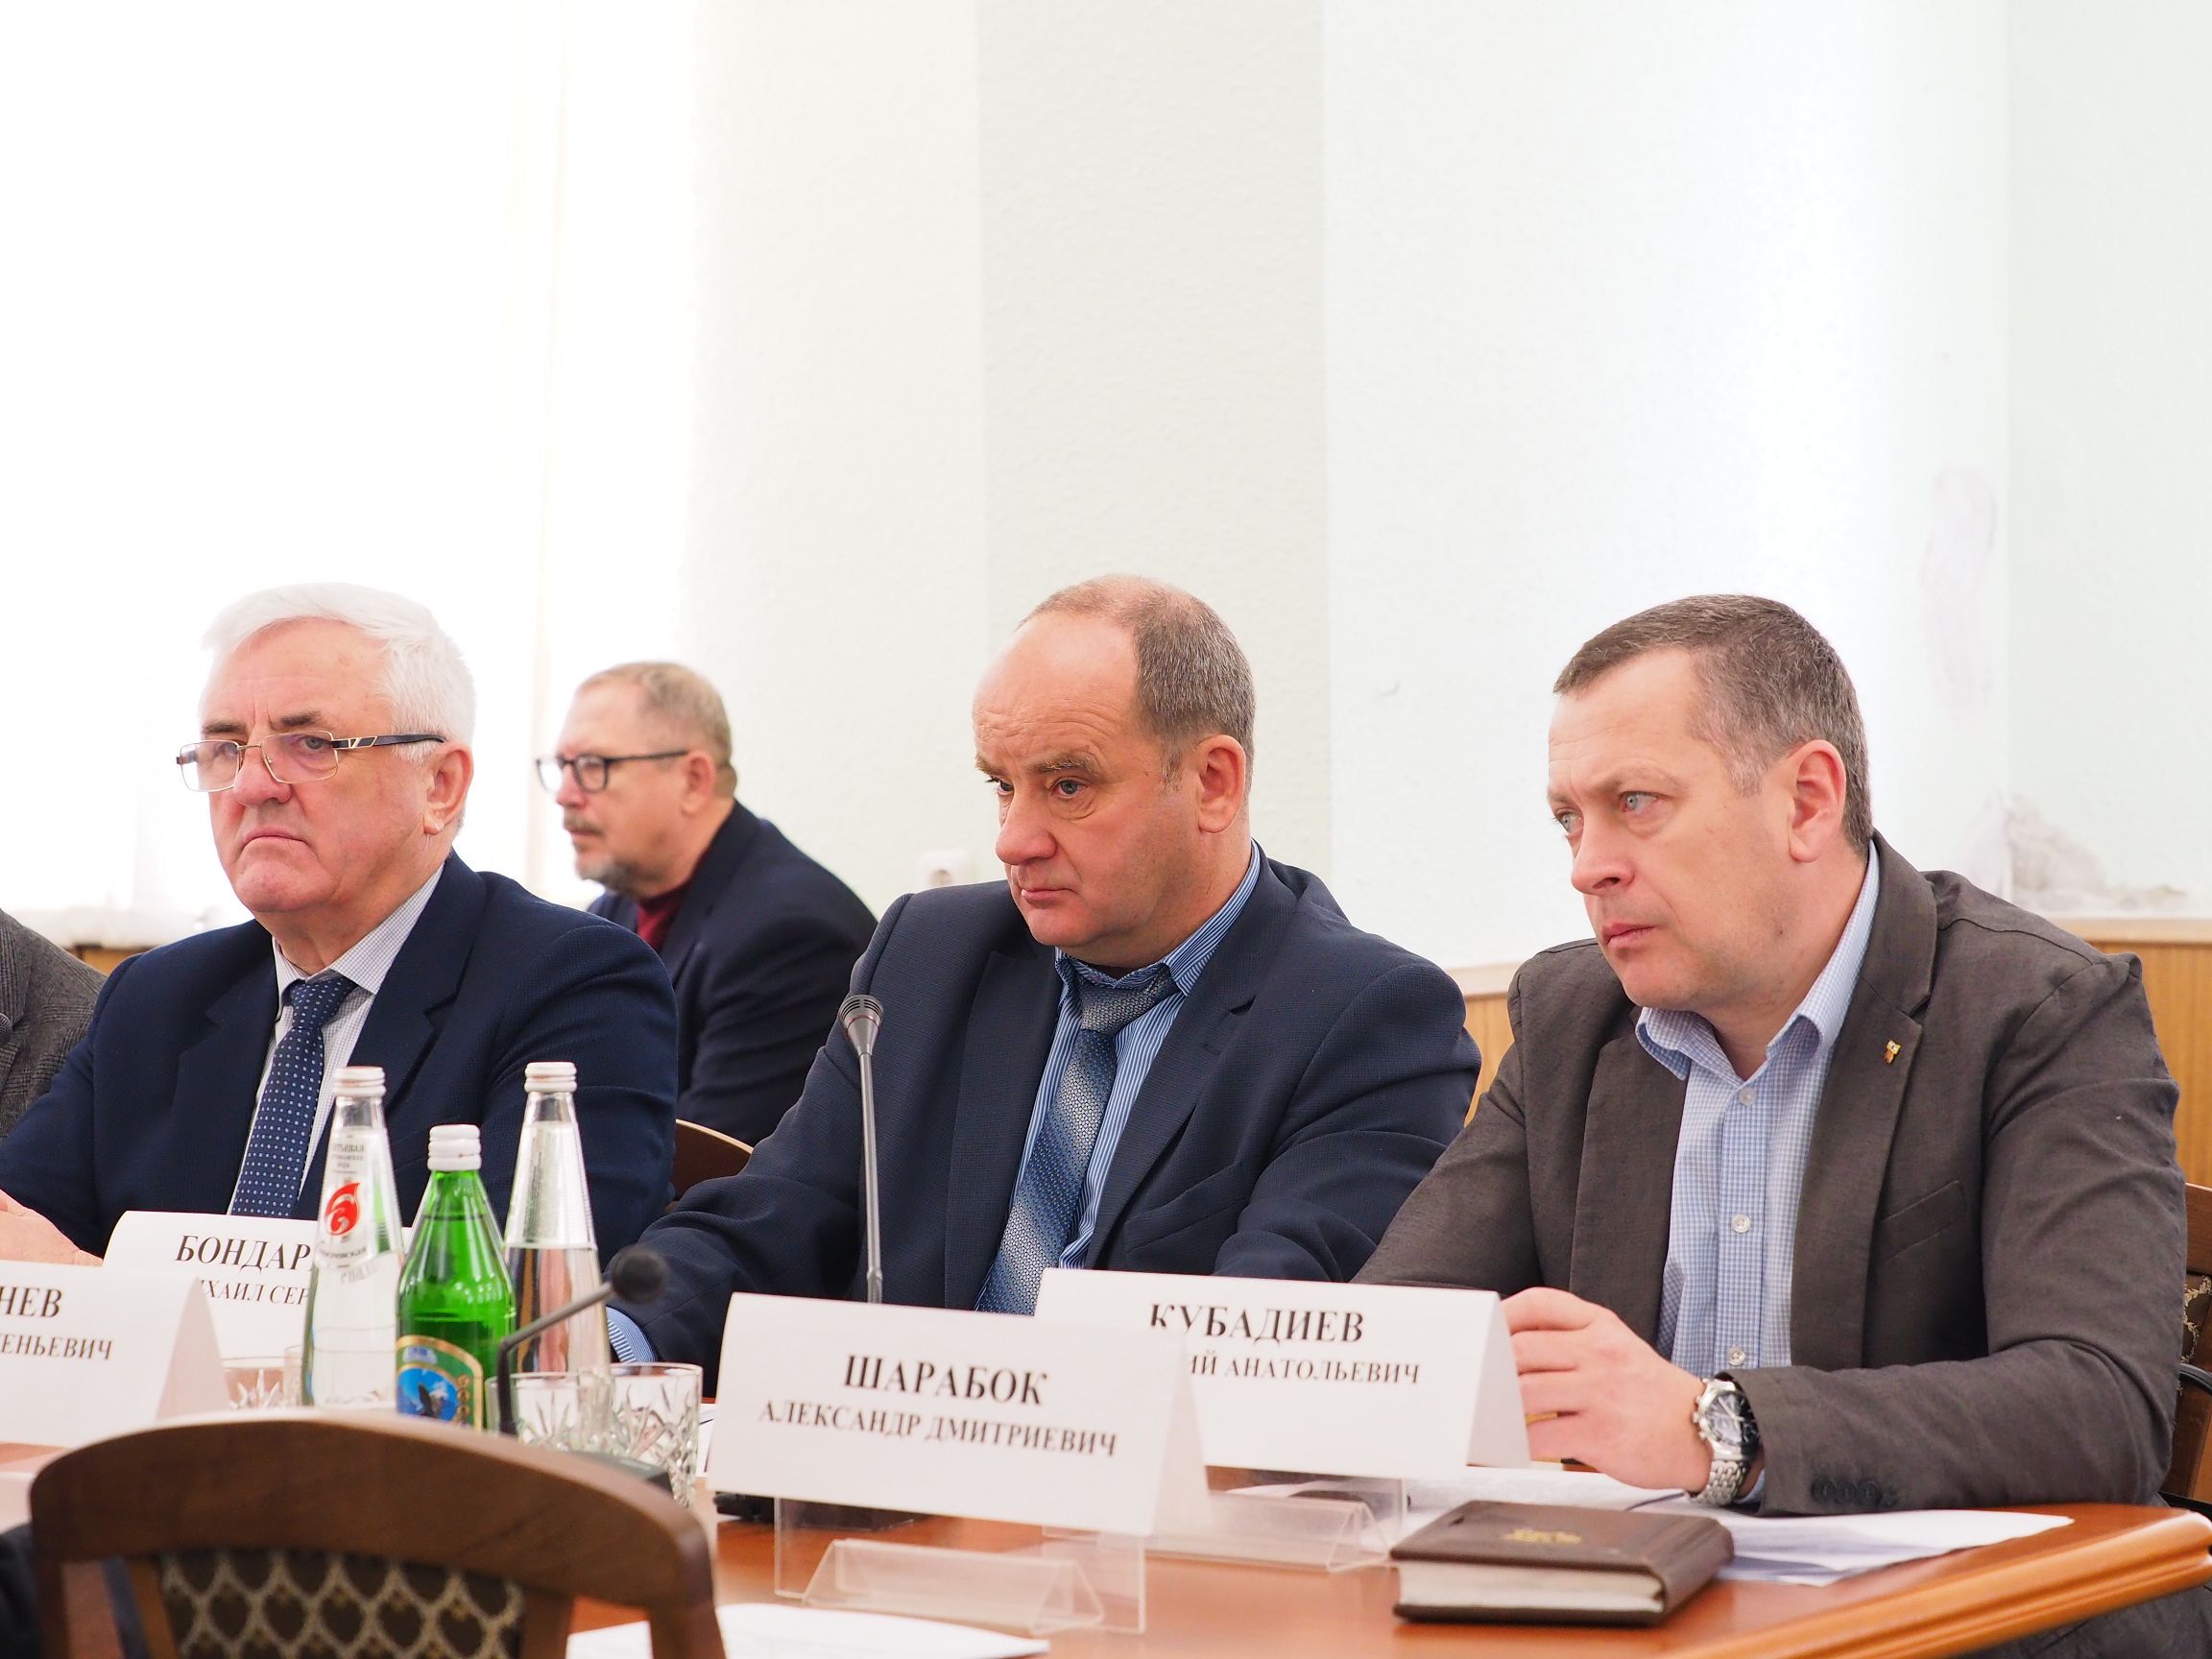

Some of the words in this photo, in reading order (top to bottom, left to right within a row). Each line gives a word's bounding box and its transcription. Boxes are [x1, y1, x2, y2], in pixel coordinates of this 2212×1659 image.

[175, 1235, 313, 1273] БОНДАР
[0, 1285, 62, 1318] НЕВ
[201, 1279, 264, 1302] ХАИЛ
[1151, 1304, 1363, 1345] КУБАДИЕВ
[0, 1333, 113, 1360] ЕНЬЕВИЧ
[843, 1354, 1048, 1407] ШАРАБОК
[1224, 1357, 1420, 1384] АНАТОЛЬЕВИЧ
[759, 1398, 922, 1439] АЛЕКСАНДР
[925, 1414, 1118, 1457] ДМИТРИЕВИЧ
